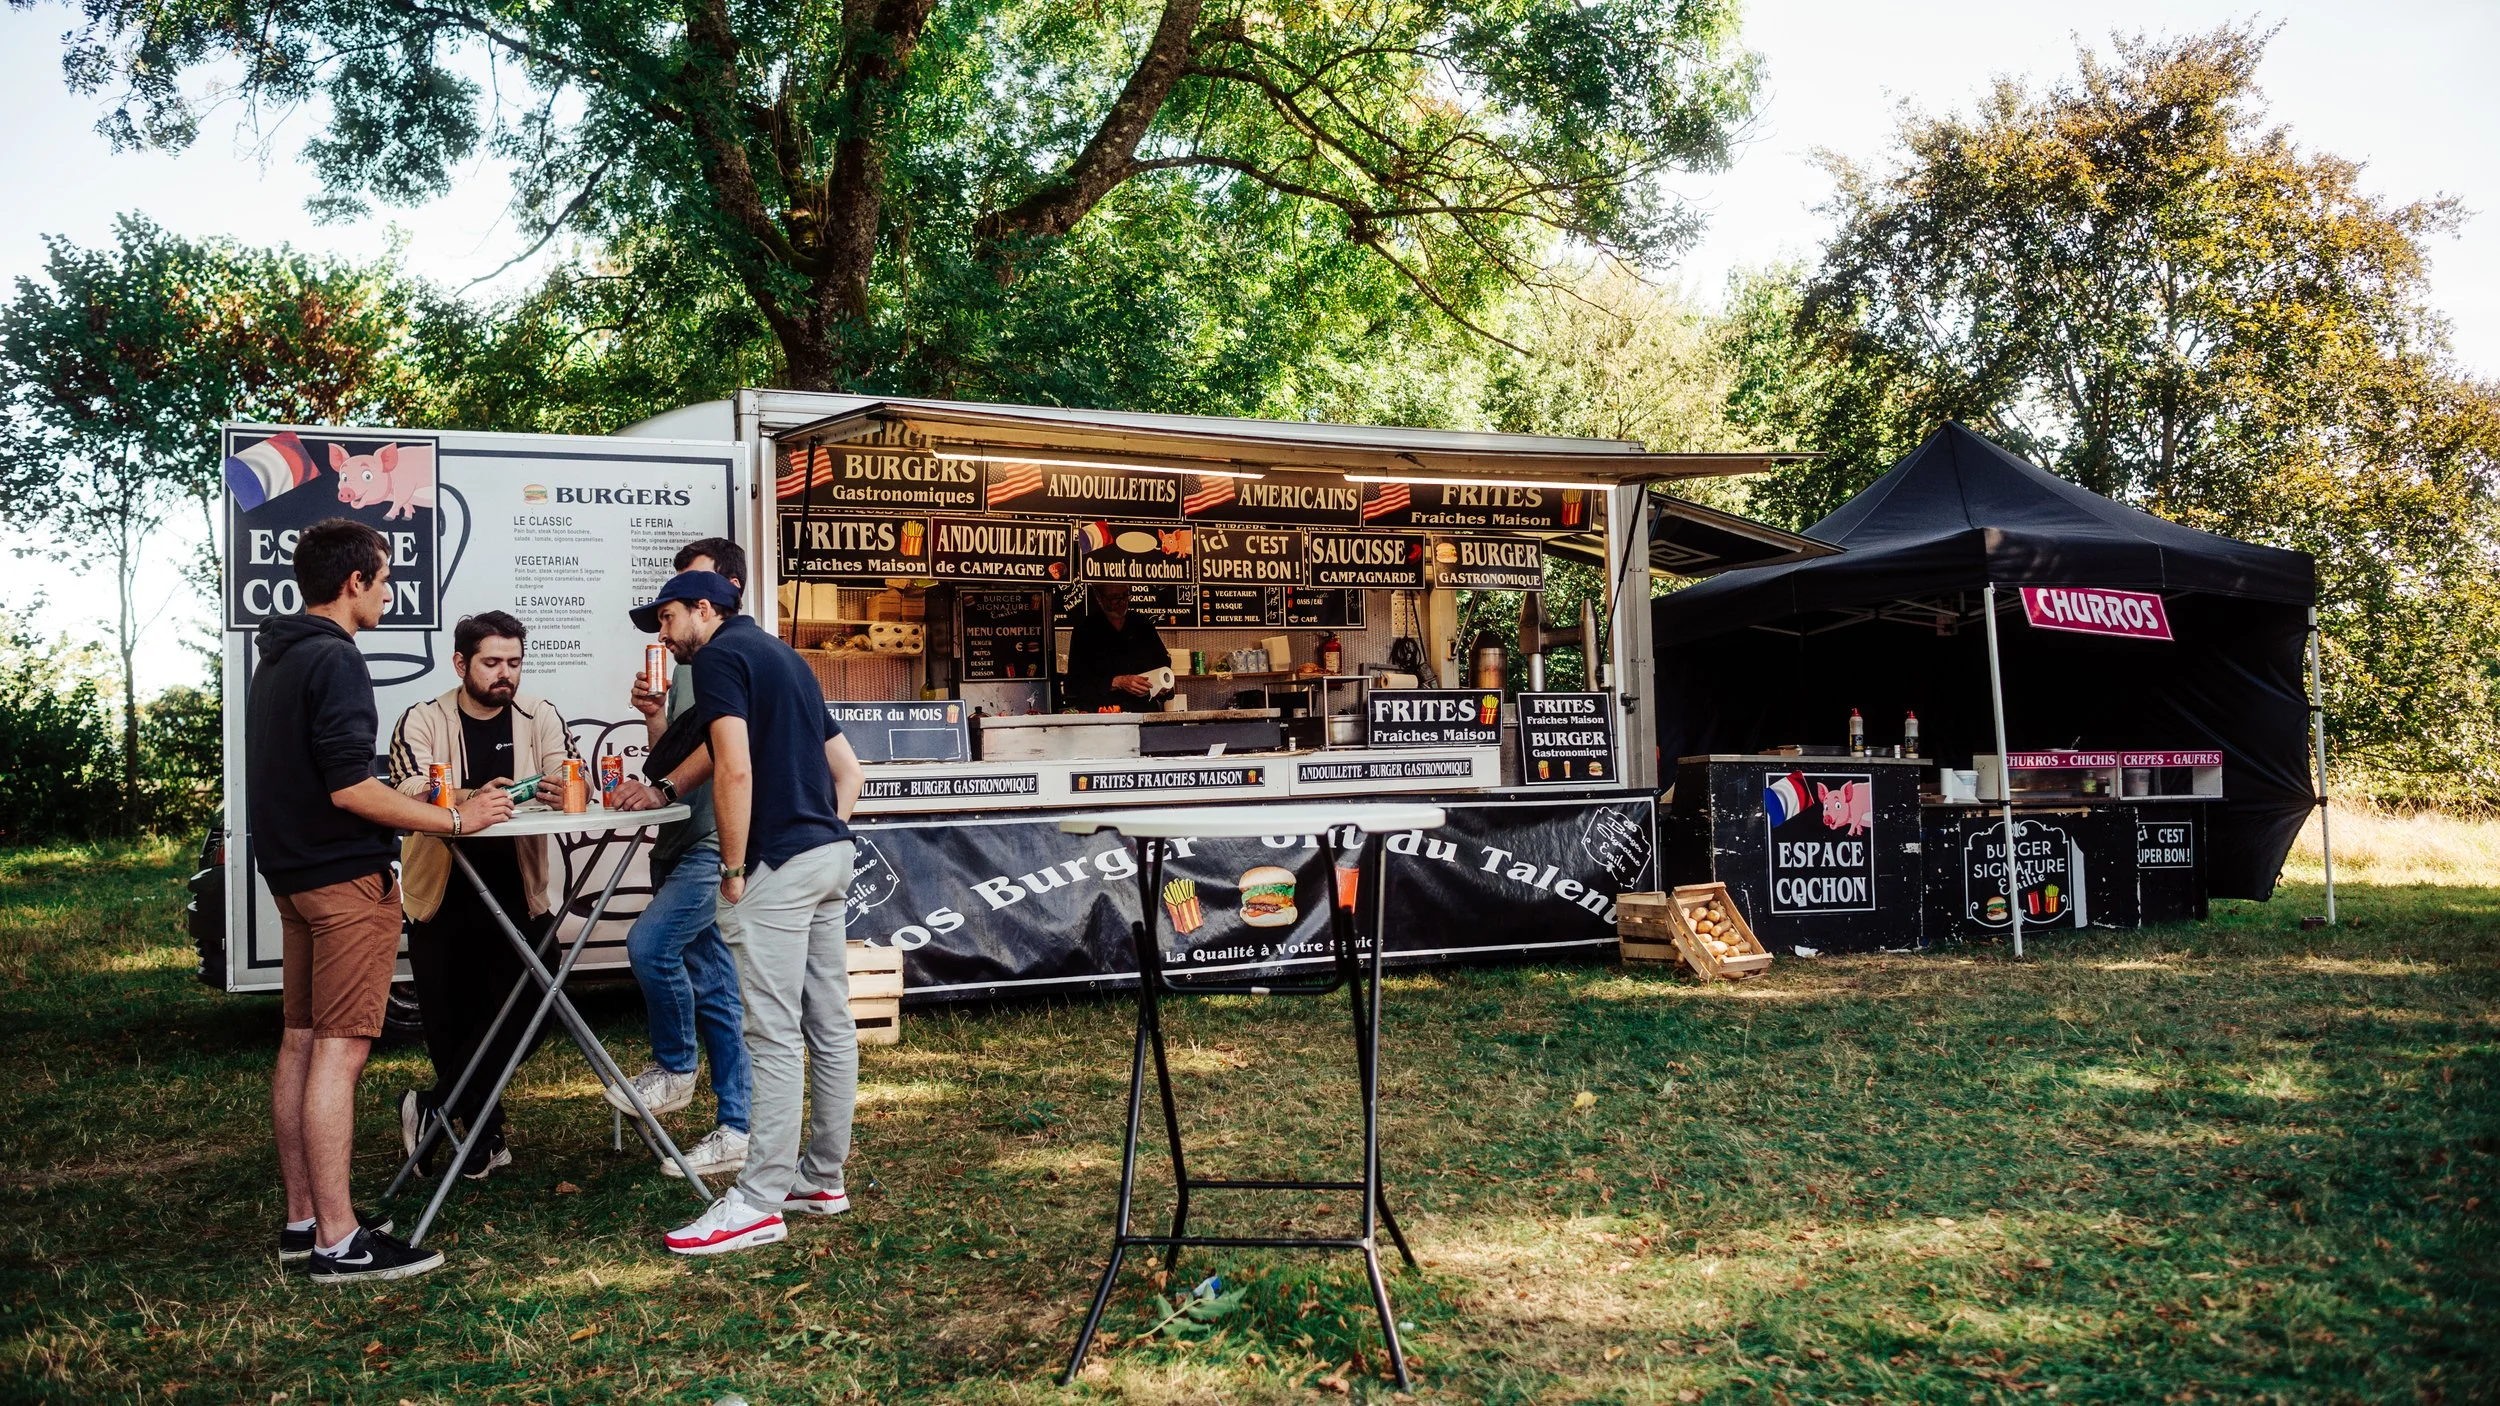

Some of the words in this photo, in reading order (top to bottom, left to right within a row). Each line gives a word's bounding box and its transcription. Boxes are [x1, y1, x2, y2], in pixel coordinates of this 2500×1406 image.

[845, 454, 976, 484] BURGERS
[556, 487, 690, 506] BURGERS
[832, 484, 975, 506] Gastronomiques
[1047, 474, 1176, 502] ANDOUILLETTES
[1238, 484, 1358, 511] AMERICAINS
[1441, 484, 1543, 508] FRITES
[514, 516, 526, 526] LE
[529, 516, 572, 526] CLASSIC
[630, 518, 641, 527] LE
[646, 518, 673, 528] FERIA
[1411, 512, 1486, 524] Fraîches
[1492, 513, 1551, 526] Maison
[793, 521, 895, 551] FRITES
[937, 524, 1067, 557] ANDOUILLETTE
[1200, 529, 1229, 553] ici
[1246, 536, 1289, 554] C'EST
[249, 529, 418, 567] ESE
[1312, 538, 1406, 565] SAUCISSE
[1460, 541, 1540, 568] BURGER
[515, 556, 579, 566] VEGETARIAN
[788, 558, 862, 571] Faîches
[868, 558, 927, 572] Maison
[936, 561, 956, 573] de
[960, 562, 1045, 576] CAMPAGNE
[1086, 556, 1101, 577] On
[1103, 560, 1126, 578] veut
[1129, 558, 1143, 578] du
[1145, 560, 1183, 579] cochon
[1202, 559, 1252, 578] SUPER
[1256, 560, 1291, 580] BON
[1320, 571, 1416, 584] CAMPAGNARDE
[1440, 572, 1541, 587] GASTRONOMIQUE
[242, 578, 422, 616] CON
[516, 597, 527, 606] LE
[531, 597, 585, 606] SAVOYARD
[2036, 588, 2159, 630] CHURROS
[967, 627, 993, 636] MENU
[996, 627, 1041, 636] COMPLET
[532, 640, 581, 650] CHEDDAR
[828, 708, 882, 720] BURGER
[887, 709, 904, 720] du
[909, 708, 942, 720] MOIS
[1374, 699, 1476, 722] FRITES
[1534, 699, 1596, 714] FRITES
[1527, 715, 1568, 724] Fraîches
[1570, 715, 1604, 724] Maison
[1374, 729, 1438, 742] Fraîches
[1443, 728, 1496, 741] Maison
[1531, 731, 1606, 746] BURGER
[1532, 748, 1608, 759] Gastronomique
[2070, 754, 2116, 766] CHICHIS
[2124, 754, 2164, 765] CREPES
[2173, 754, 2219, 764] GAUFRES
[1093, 774, 1134, 789] FRITES
[1137, 772, 1195, 788] FRAICHES
[1199, 771, 1242, 785] MAISON
[1300, 765, 1362, 780] ANDOUILLETTE
[1370, 763, 1402, 777] BURGER
[1404, 761, 1470, 776] GASTRONOMIQUE
[861, 782, 902, 797] ILLETTE
[910, 780, 951, 795] BURGER
[954, 777, 1035, 794] GASTRONOMIQUE
[2138, 825, 2148, 841] ci
[2158, 828, 2184, 843] C'EST
[1778, 842, 1864, 868] ESPACE
[2138, 848, 2162, 863] UPER
[2164, 848, 2185, 863] BON
[846, 883, 877, 908] milie
[864, 905, 965, 951] os
[970, 836, 1198, 912] Burger
[1386, 830, 1457, 864] du
[1480, 845, 1618, 925] Talent
[1165, 951, 1186, 963] La
[1192, 944, 1255, 962] Qualité
[1261, 944, 1270, 956] à
[1276, 940, 1324, 955] Votre
